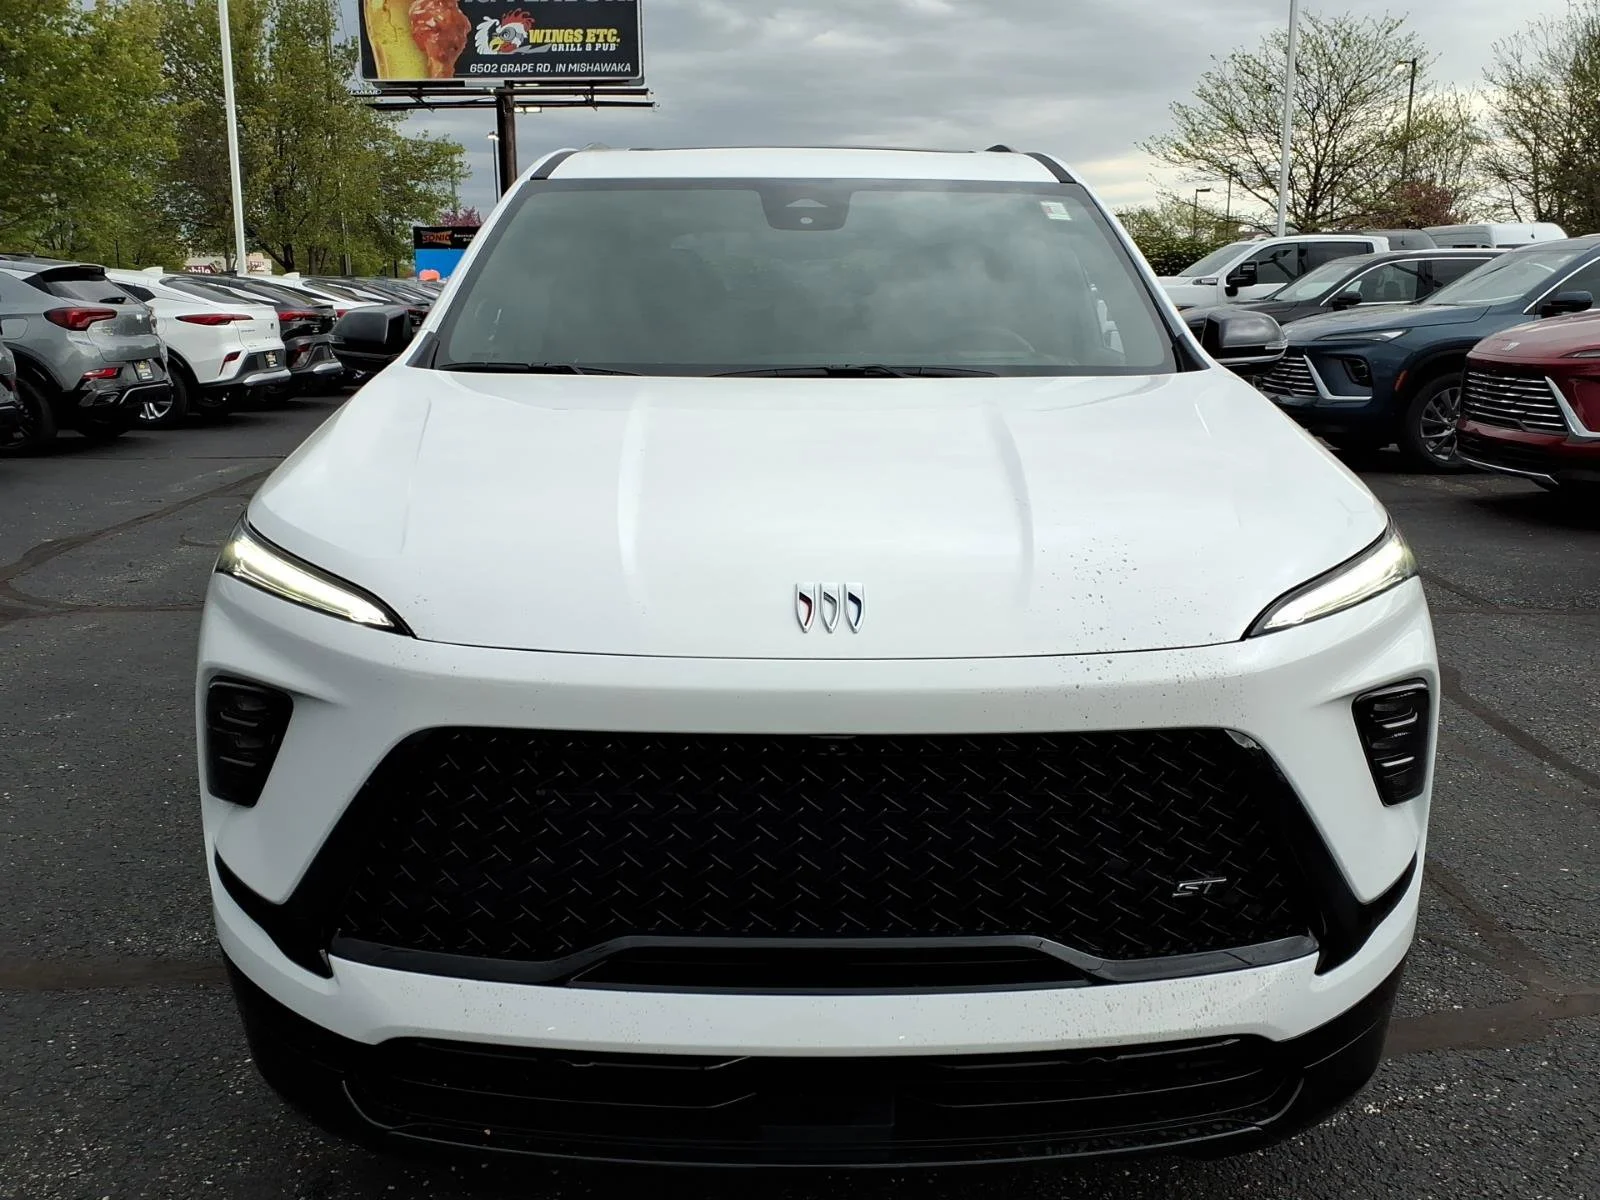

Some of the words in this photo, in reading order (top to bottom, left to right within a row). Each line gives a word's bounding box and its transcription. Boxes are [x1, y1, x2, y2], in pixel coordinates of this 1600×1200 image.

[529, 29, 584, 43] WINGS
[585, 28, 620, 43] ETC.
[551, 43, 582, 51] GRILL
[585, 43, 591, 51] &
[595, 43, 616, 51] PUB
[470, 63, 498, 73] 6502
[500, 63, 534, 73] GRAPE
[536, 63, 553, 73] RD.
[555, 63, 566, 73] IN
[568, 62, 631, 72] MISHAWAKA
[423, 233, 450, 242] SONIC
[1172, 876, 1227, 897] ST
